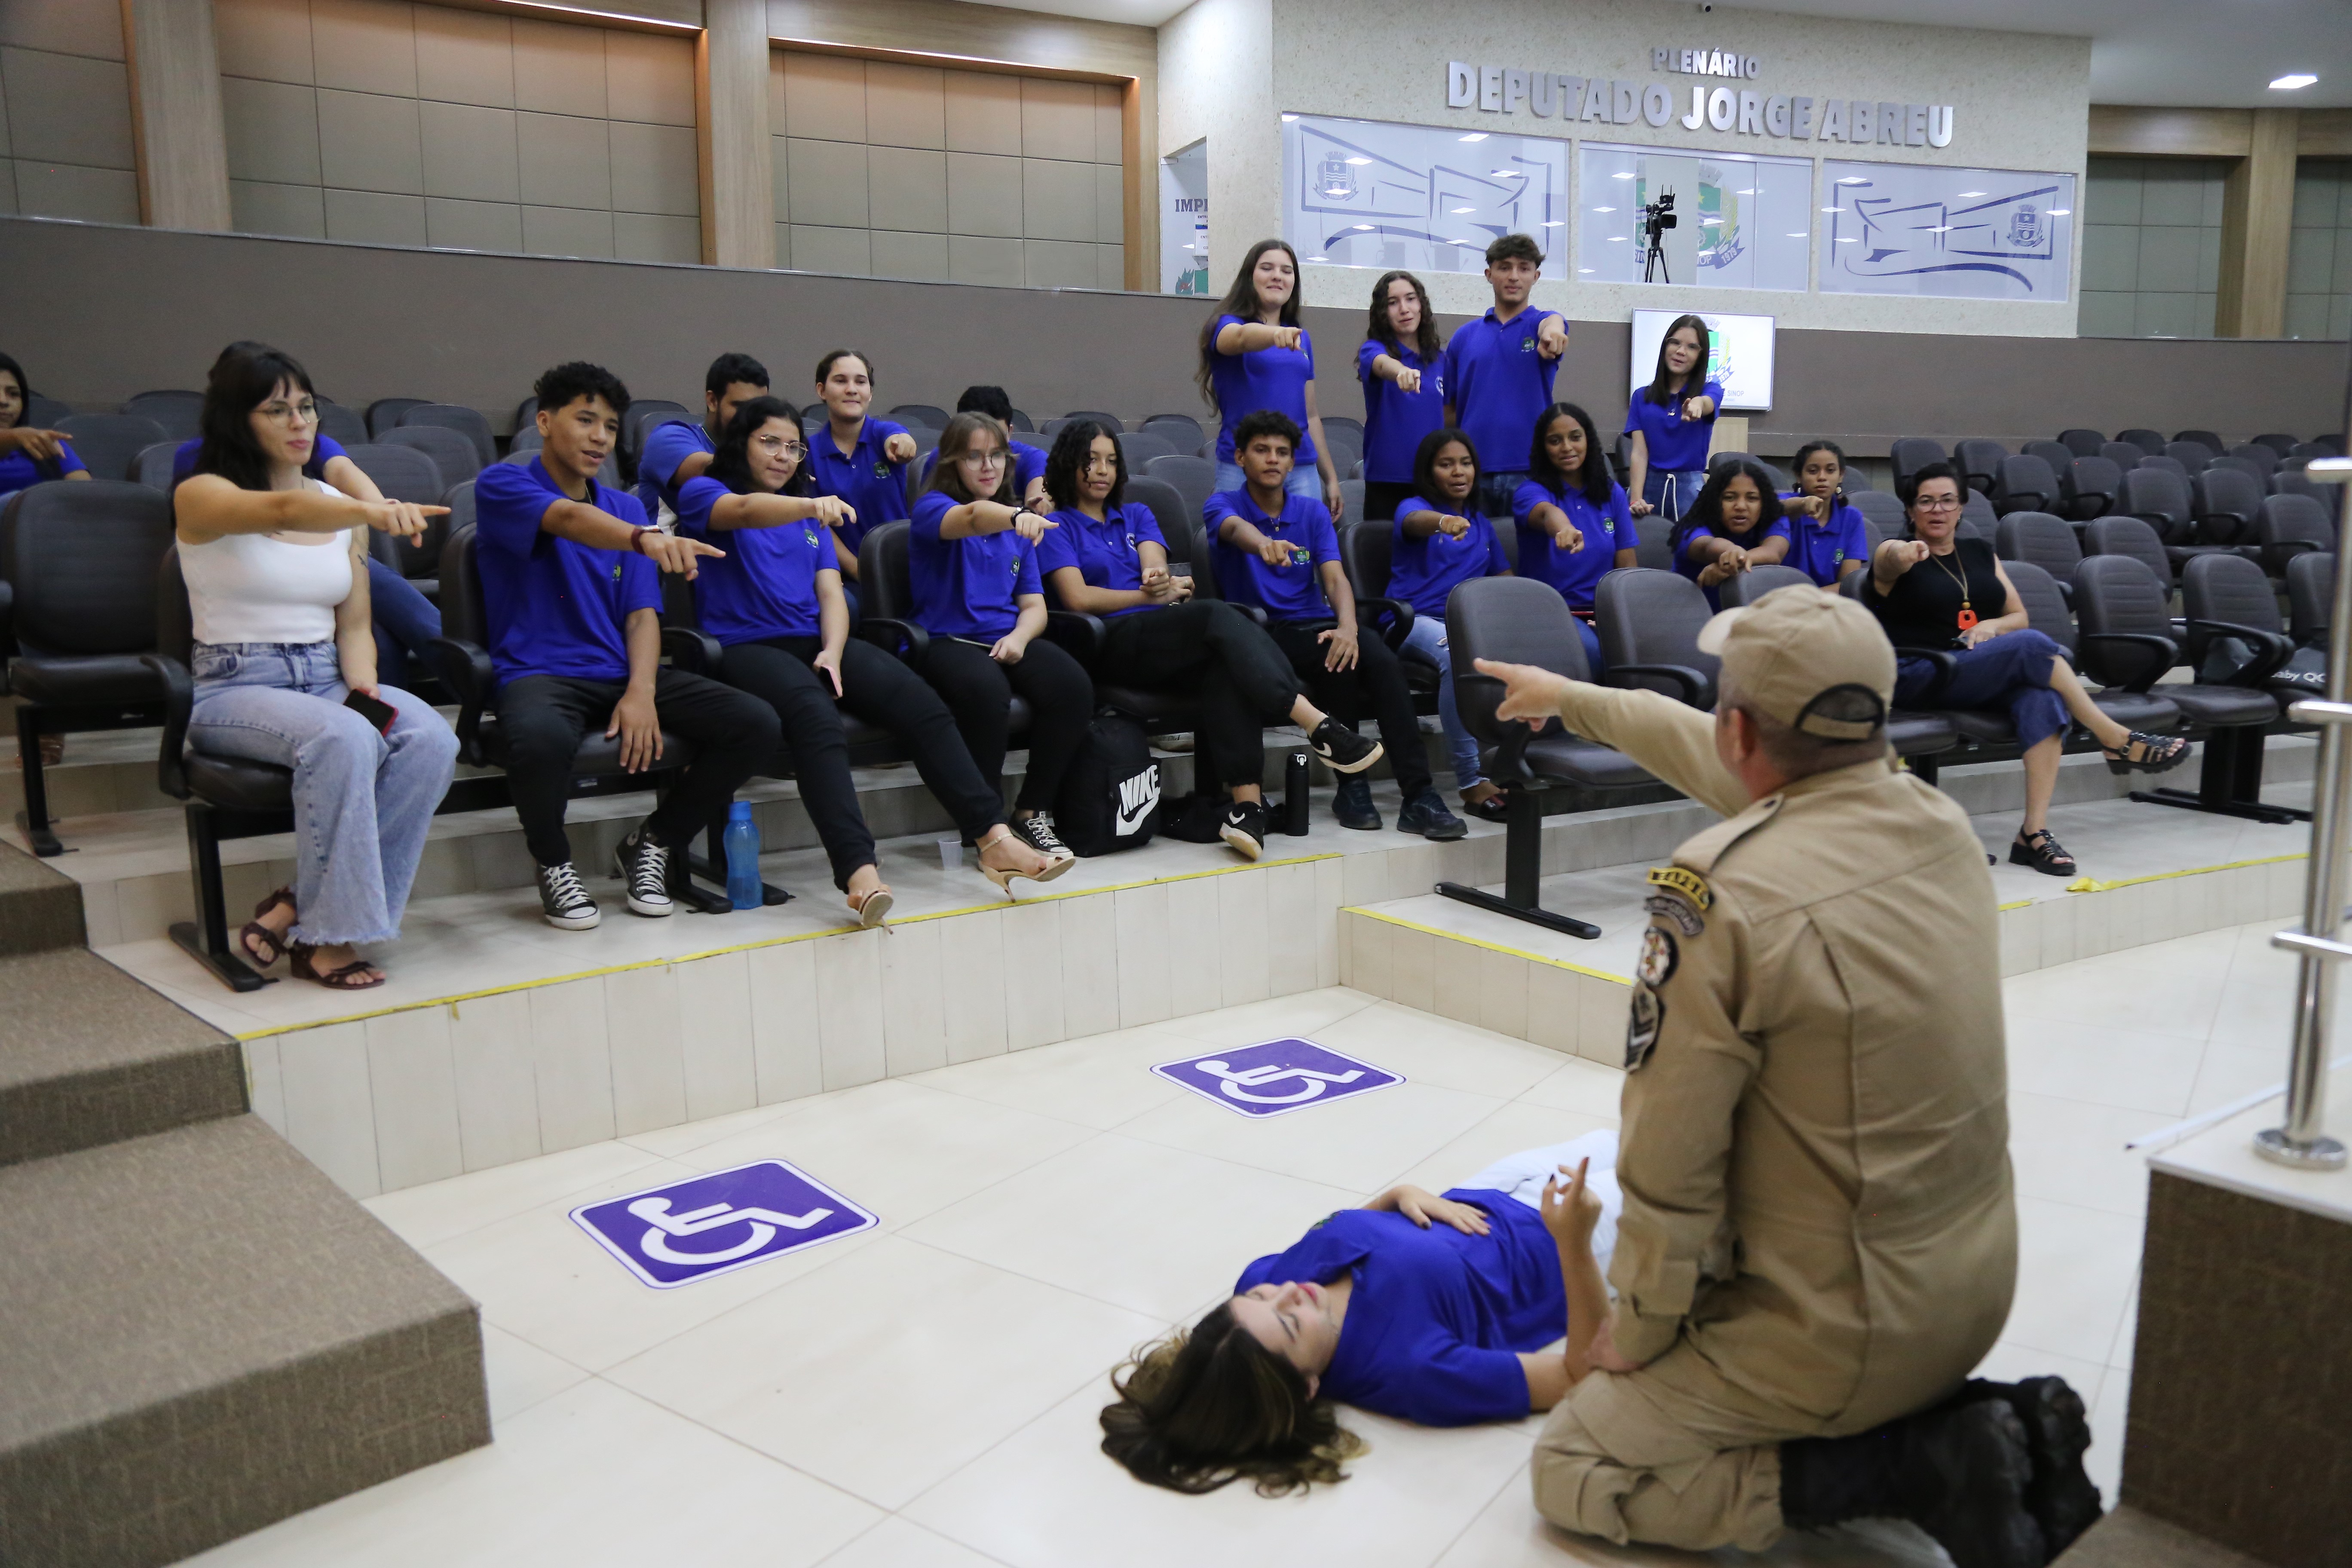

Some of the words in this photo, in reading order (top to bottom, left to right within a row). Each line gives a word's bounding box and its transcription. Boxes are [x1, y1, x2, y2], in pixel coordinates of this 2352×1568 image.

[1652, 47, 1761, 80] PLENÁRIO
[1447, 61, 1672, 128] DEPUTADO
[1681, 86, 1813, 141] JORGE
[1817, 99, 1954, 148] ABREU
[1119, 765, 1161, 816] NIKE
